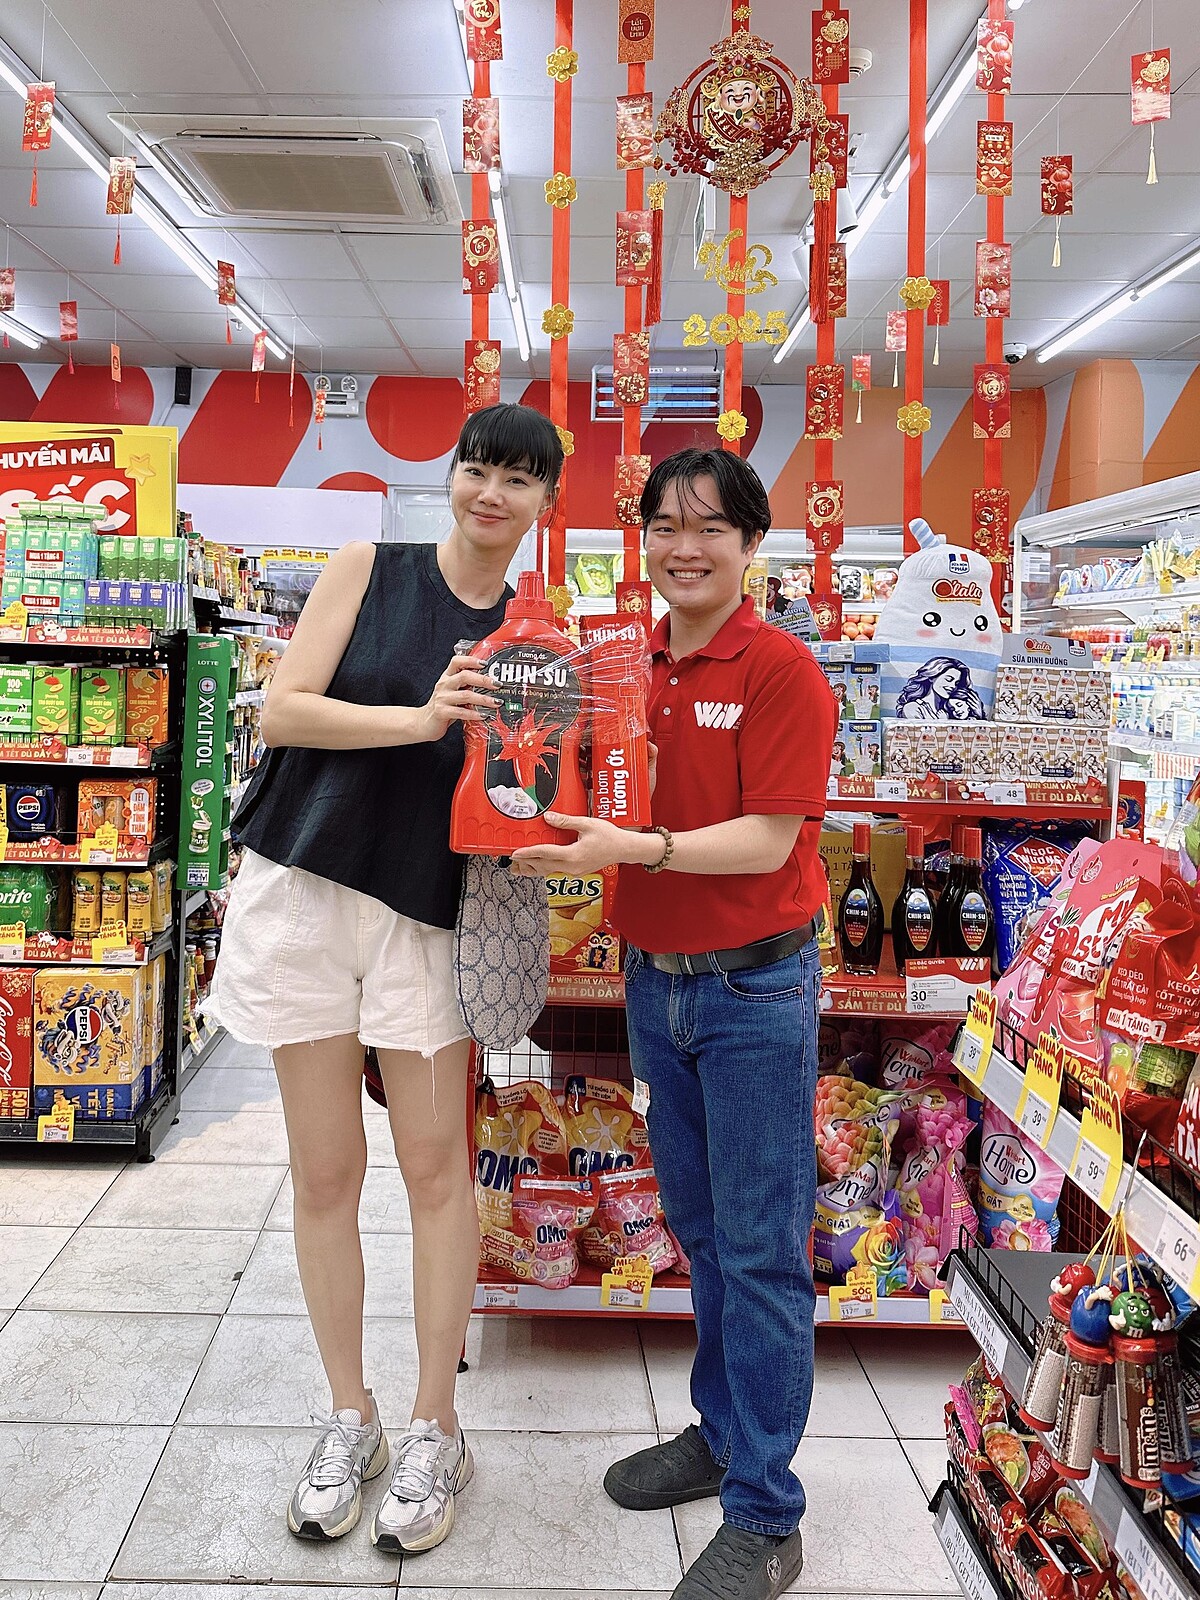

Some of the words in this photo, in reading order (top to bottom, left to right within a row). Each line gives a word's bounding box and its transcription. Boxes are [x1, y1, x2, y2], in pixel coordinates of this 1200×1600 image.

[683, 310, 789, 347] 2025
[71, 442, 111, 464] MÃI
[0, 475, 131, 532] SC
[587, 627, 637, 643] CHIN-SU
[1012, 655, 1026, 664] SỮA
[488, 661, 568, 688] CHIN-SU
[196, 695, 215, 769] XYLITOL
[597, 770, 609, 796] bơm
[842, 781, 866, 795] SẮM
[1026, 782, 1042, 790] WIN
[611, 769, 630, 819] Tương
[1006, 790, 1018, 798] 48
[1030, 791, 1047, 802] TẾT
[1049, 792, 1065, 803] ĐỦ
[846, 908, 868, 917] CHIN-SU
[907, 912, 931, 920] CHIN-SU
[962, 912, 986, 920] CHIN-SU
[17, 923, 24, 931] 2
[119, 931, 125, 939] 1
[1063, 959, 1076, 972] MUA
[557, 976, 574, 984] WIN
[560, 984, 578, 996] TẾT
[579, 985, 596, 997] ĐỦ
[848, 988, 861, 998] TẾT
[910, 991, 927, 1002] 30
[976, 988, 990, 1006] MUA
[837, 998, 863, 1010] SẮM
[866, 998, 884, 1011] TẾT
[989, 997, 997, 1029] 1
[79, 1008, 88, 1042] PEPSI
[1109, 1011, 1120, 1024] MUA
[1121, 1013, 1126, 1026] 1
[1128, 1017, 1151, 1033] TẶNG
[1154, 1024, 1163, 1038] 1
[968, 1046, 978, 1060] 39
[1039, 1034, 1056, 1055] MUA
[1056, 1047, 1064, 1083] 1
[1093, 1079, 1112, 1104] MUA
[1032, 1109, 1042, 1127] 39
[1111, 1094, 1121, 1136] 1
[477, 1148, 540, 1194] OMO
[568, 1147, 634, 1177] OMO
[985, 1140, 1030, 1184] Home
[1087, 1161, 1099, 1181] 59
[536, 1224, 568, 1245] OMO
[622, 1216, 654, 1237] OMO
[1173, 1237, 1188, 1262] 66
[852, 1285, 872, 1296] SỐC
[841, 1308, 854, 1316] 117
